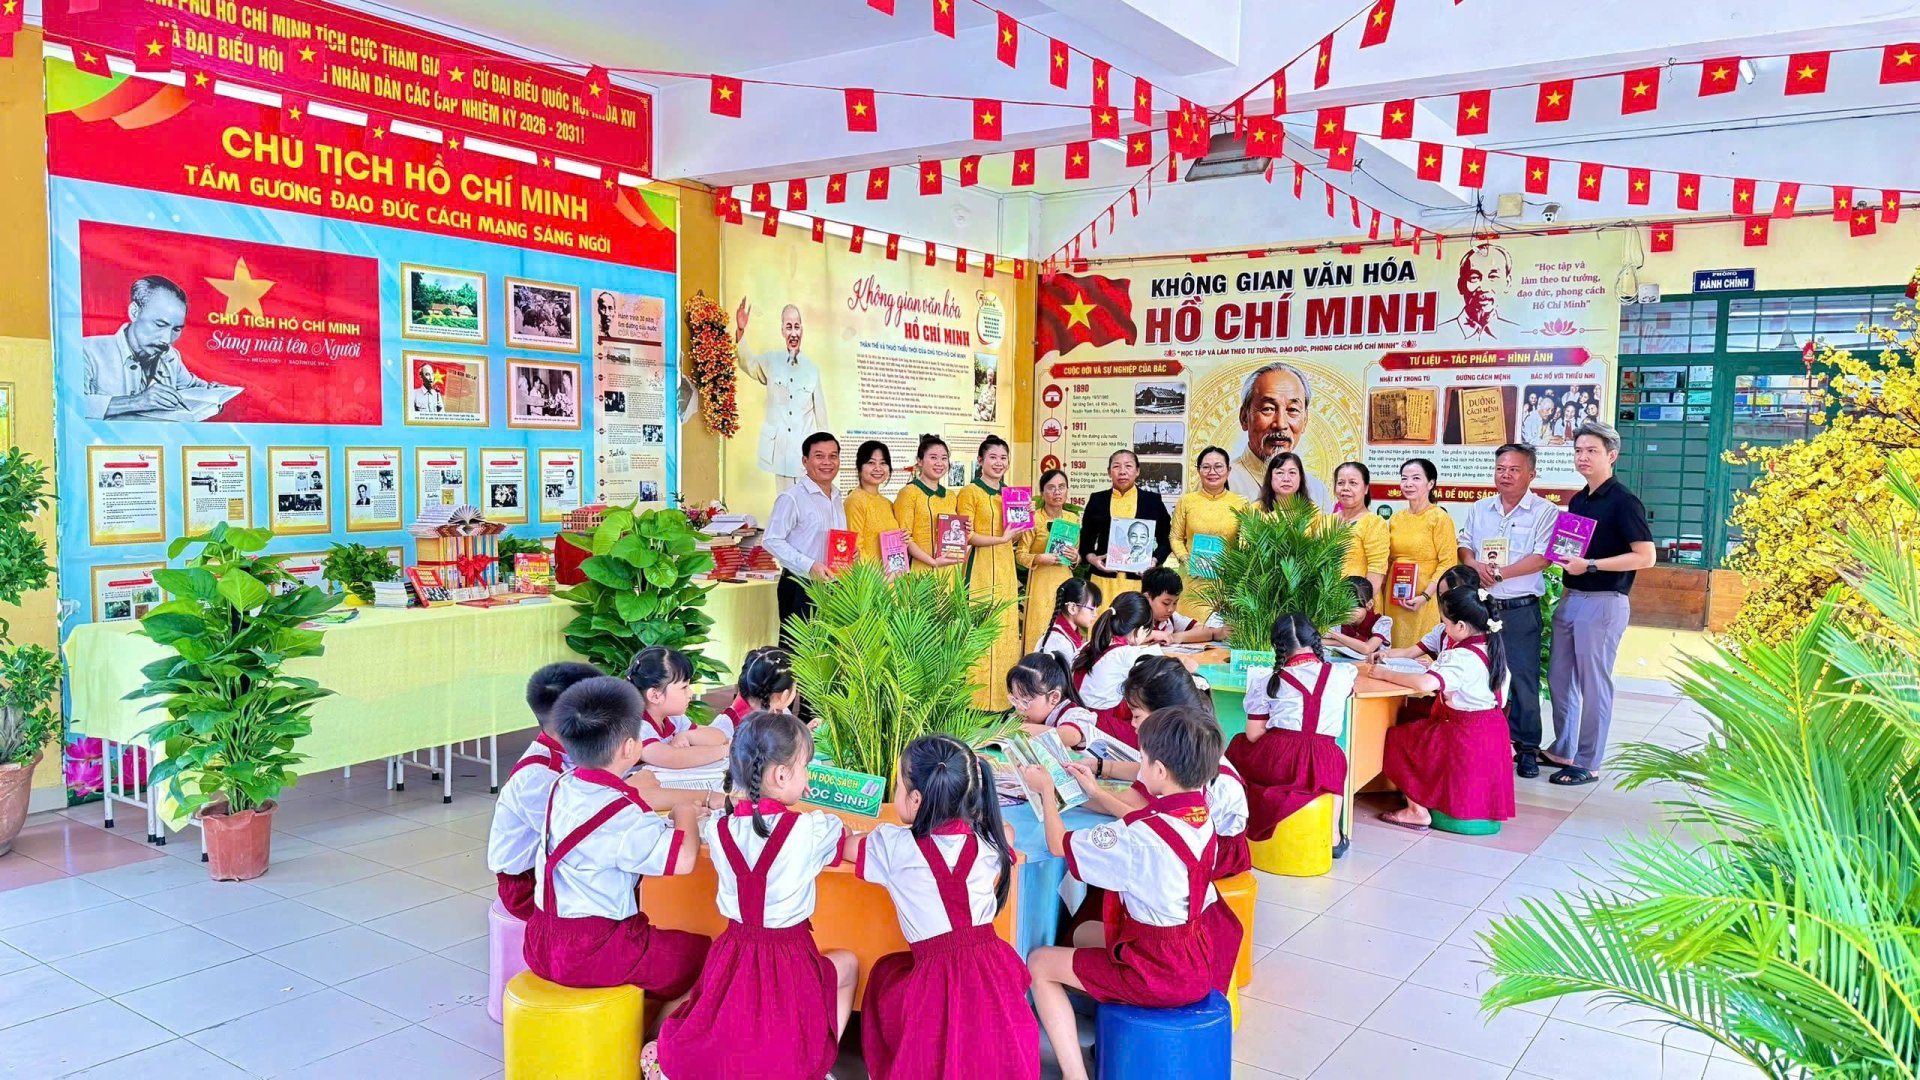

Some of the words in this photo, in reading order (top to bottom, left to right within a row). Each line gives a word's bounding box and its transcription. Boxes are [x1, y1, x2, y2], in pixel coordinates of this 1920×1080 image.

[185, 27, 213, 59] ĐẠI
[218, 32, 254, 65] BIỂU
[259, 44, 284, 76] HỘI
[242, 0, 267, 33] CHÍ
[272, 13, 311, 39] MINH
[315, 23, 347, 53] TÍCH
[351, 35, 377, 64] CỰC
[381, 43, 418, 73] THAM
[473, 64, 490, 90] CỬ
[491, 73, 511, 99] ĐẠI
[514, 76, 538, 104] BIỂU
[542, 82, 569, 111] QUỐC
[620, 107, 636, 129] XVI
[331, 64, 370, 94] NHÂN
[374, 74, 402, 101] DÂN
[405, 81, 430, 108] CÁC
[462, 98, 499, 125] NHIỆM
[502, 104, 517, 128] KỲ
[520, 113, 546, 135] 2026
[556, 121, 585, 145] 2031!
[221, 126, 304, 169] CHỦ
[315, 143, 393, 186] TỊCH
[405, 153, 450, 195] HỒ
[460, 173, 513, 208] CHÍ
[521, 185, 588, 222] MINH
[184, 162, 241, 192] TẤM
[250, 176, 322, 206] GƯƠNG
[330, 190, 374, 215] ĐẠO
[381, 198, 420, 222] ĐỨC
[426, 205, 472, 230] CÁCH
[478, 215, 528, 239] MẠNG
[533, 224, 574, 248] SÁNG
[1558, 261, 1572, 272] tập
[1575, 260, 1585, 269] và
[1151, 272, 1227, 298] KHÔNG
[1236, 268, 1293, 292] GIAN
[1303, 260, 1352, 288] VĂN
[1362, 255, 1416, 284] HÓA
[1521, 277, 1537, 285] làm
[1540, 275, 1559, 284] theo
[1700, 277, 1722, 289] HÀNH
[1723, 276, 1749, 289] CHÍNH
[1517, 289, 1533, 299] đạo
[1535, 288, 1553, 297] đức,
[1556, 287, 1583, 297] phong
[1585, 285, 1606, 295] cách
[847, 274, 896, 326] Không
[895, 290, 922, 327] gian
[922, 296, 943, 316] văn
[942, 288, 962, 319] hóa
[1547, 300, 1560, 309] Chí
[1146, 296, 1202, 344] HỒ
[1214, 292, 1295, 341] CHÍ
[1304, 291, 1439, 338] MINH
[302, 319, 325, 332] CHÍ
[328, 321, 361, 336] MINH
[904, 316, 920, 340] HỒ
[923, 322, 941, 343] CHÍ
[943, 328, 970, 347] MINH
[207, 329, 251, 355] Sáng
[254, 336, 284, 353] mãi
[286, 338, 308, 355] tên
[311, 338, 362, 361] Người
[1231, 347, 1245, 355] THEO
[1310, 344, 1332, 352] PHONG
[1334, 342, 1352, 351] CÁCH
[1364, 341, 1376, 350] CHÍ
[1409, 355, 1422, 365] TƯ
[1422, 355, 1441, 367] LIỆU
[1451, 353, 1468, 364] TÁC
[1470, 352, 1496, 363] PHẨM
[1508, 351, 1530, 362] HÌNH
[1533, 350, 1553, 362] ẢNH
[1063, 366, 1080, 375] CUỘC
[1103, 365, 1112, 375] SỰ
[1113, 364, 1137, 375] NGHIỆP
[1139, 363, 1152, 373] CỦA
[1153, 363, 1167, 373] BÁC
[1477, 373, 1493, 381] CÁCH
[1073, 384, 1089, 393] 1890
[1072, 422, 1087, 430] 1911
[1071, 461, 1086, 469] 1930
[1445, 487, 1456, 498] ĐỂ
[1458, 489, 1475, 501] ĐỌC
[1070, 497, 1086, 506] 1945
[819, 773, 835, 785] ĐỌC
[834, 791, 868, 808] SINH
